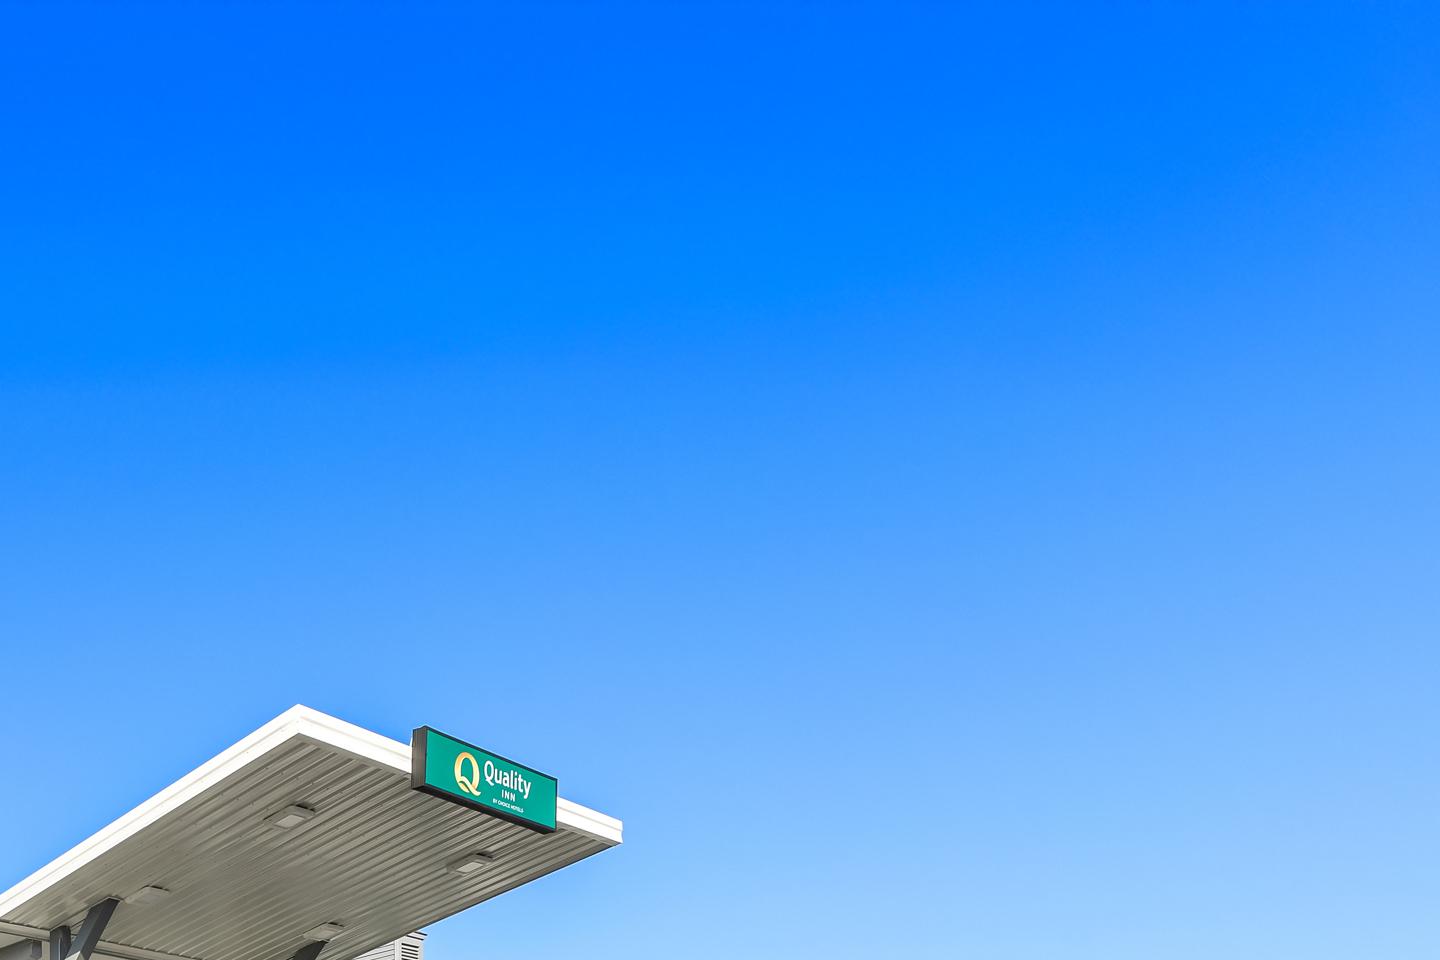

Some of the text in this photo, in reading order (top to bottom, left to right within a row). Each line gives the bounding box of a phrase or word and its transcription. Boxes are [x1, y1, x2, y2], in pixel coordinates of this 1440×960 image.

[454, 752, 481, 796] Q
[484, 760, 531, 799] Quality
[501, 789, 516, 802] INN
